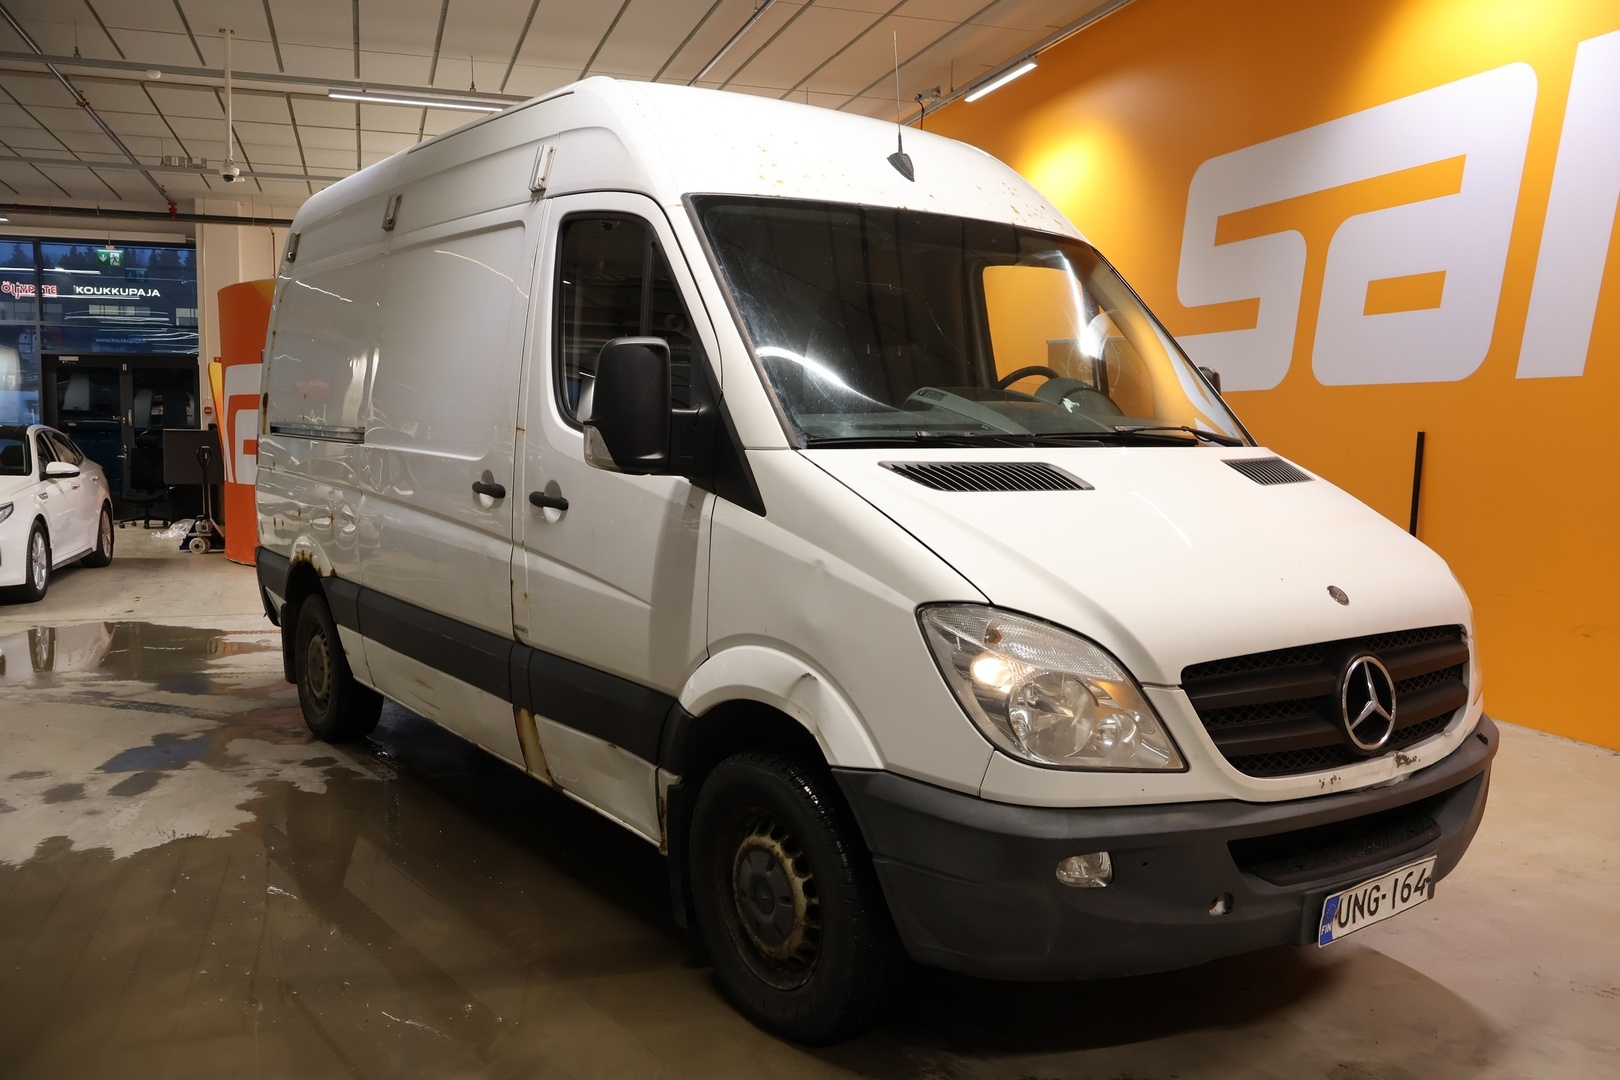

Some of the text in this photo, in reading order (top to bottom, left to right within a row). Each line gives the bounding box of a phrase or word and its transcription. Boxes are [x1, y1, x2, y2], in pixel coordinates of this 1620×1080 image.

[76, 286, 161, 297] KOUKKUPAJA
[1337, 867, 1428, 929] UNG-164
[1320, 922, 1333, 936] FIN
